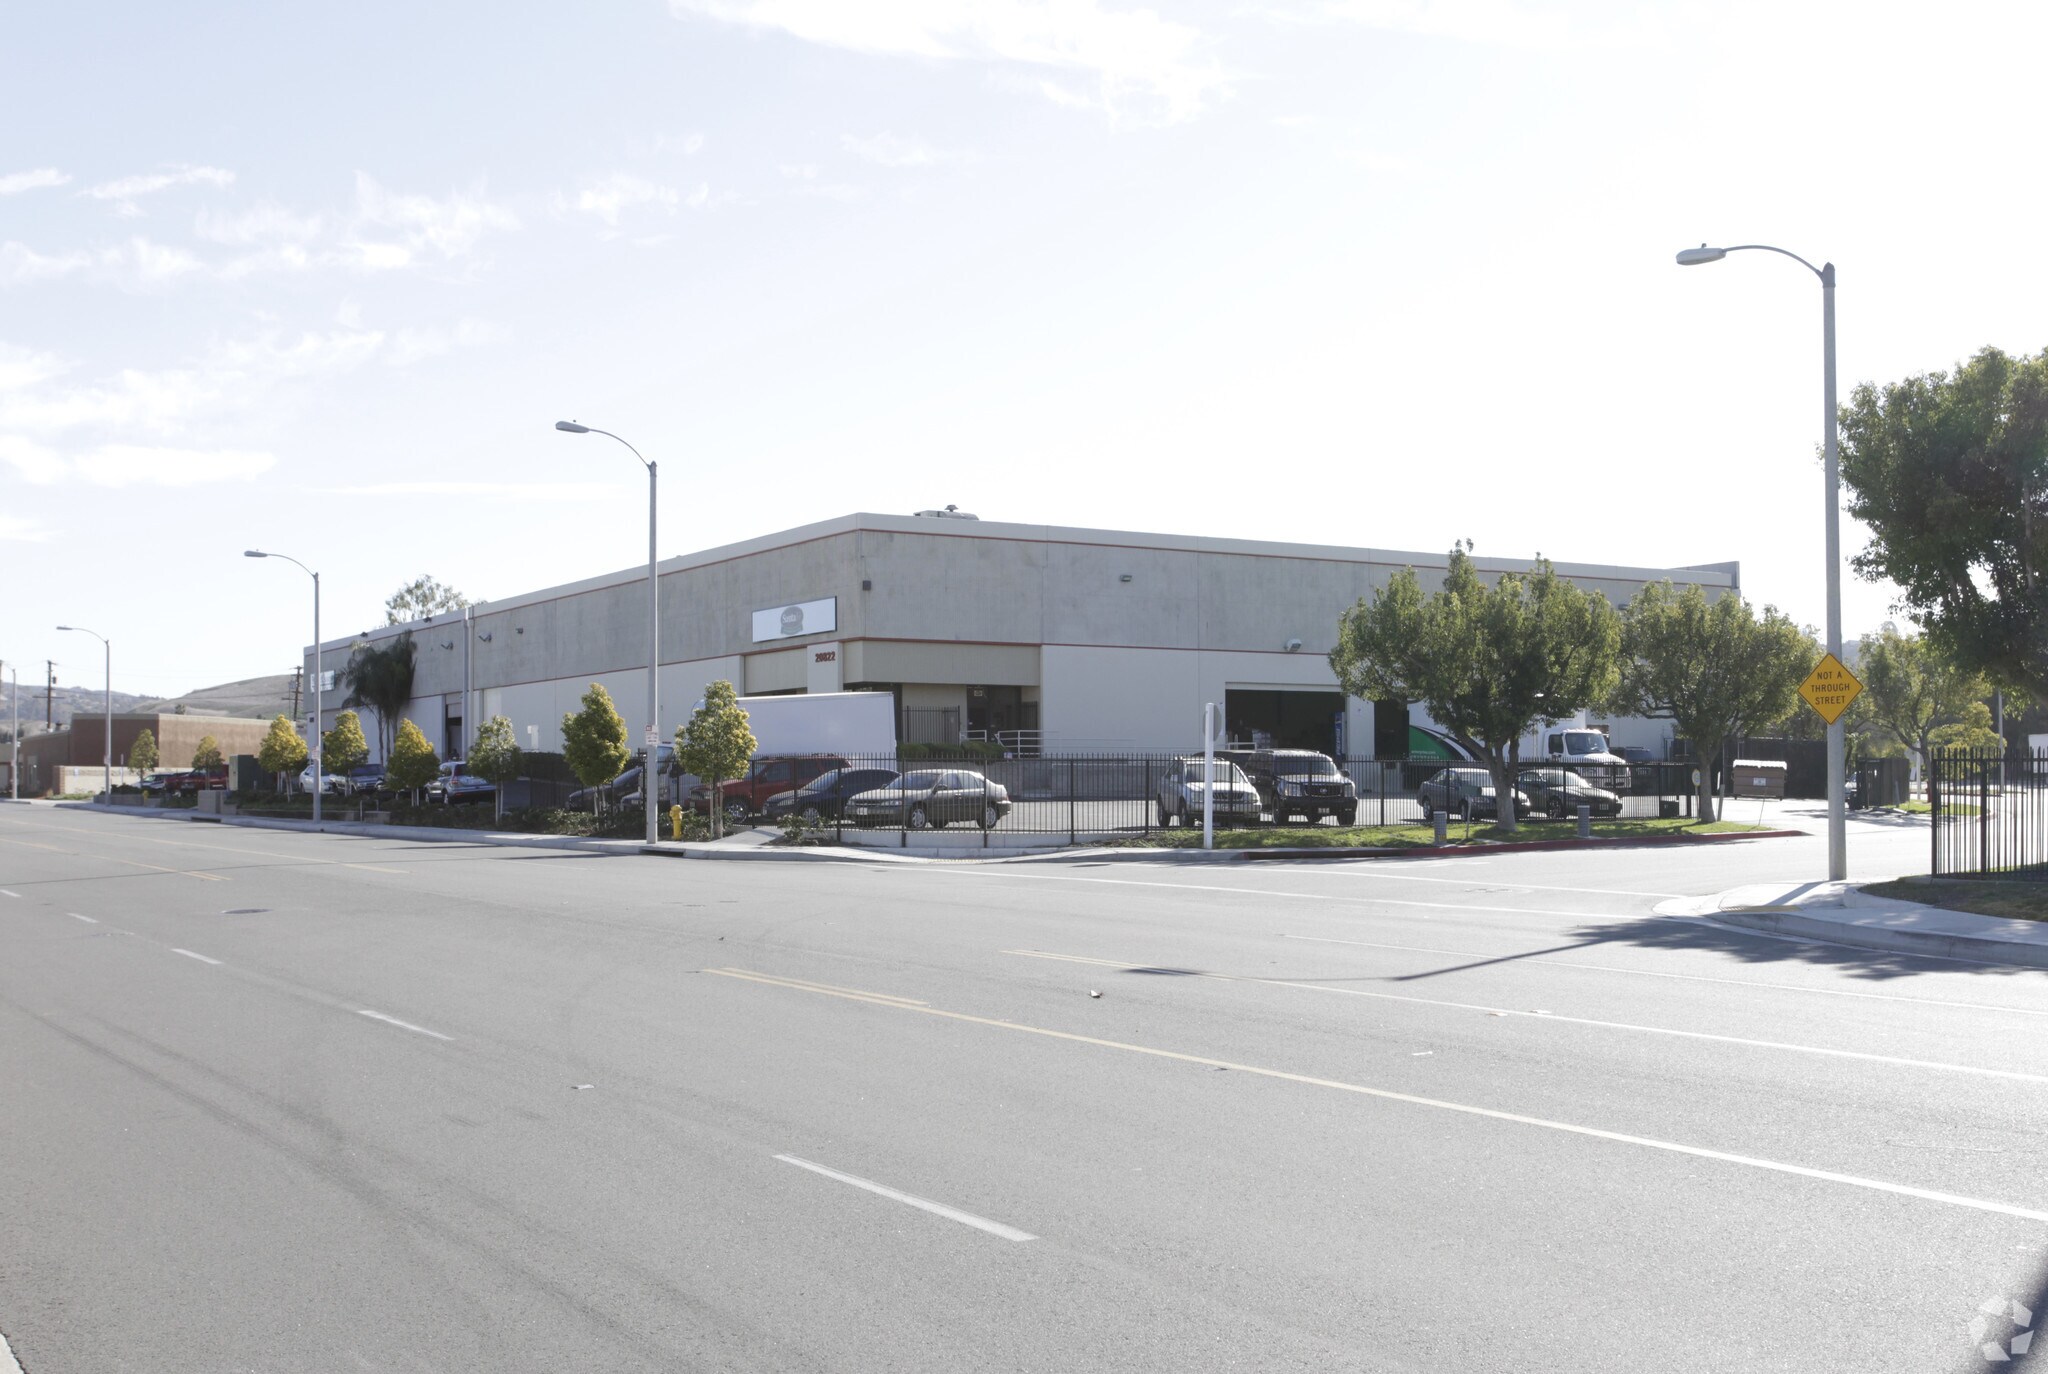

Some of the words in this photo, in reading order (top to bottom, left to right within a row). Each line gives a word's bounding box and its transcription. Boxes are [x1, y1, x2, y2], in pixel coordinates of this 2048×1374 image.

[1817, 671, 1832, 680] NOT
[1837, 671, 1843, 680] A
[1811, 683, 1850, 693] THROUGH
[1815, 695, 1846, 705] STREET
